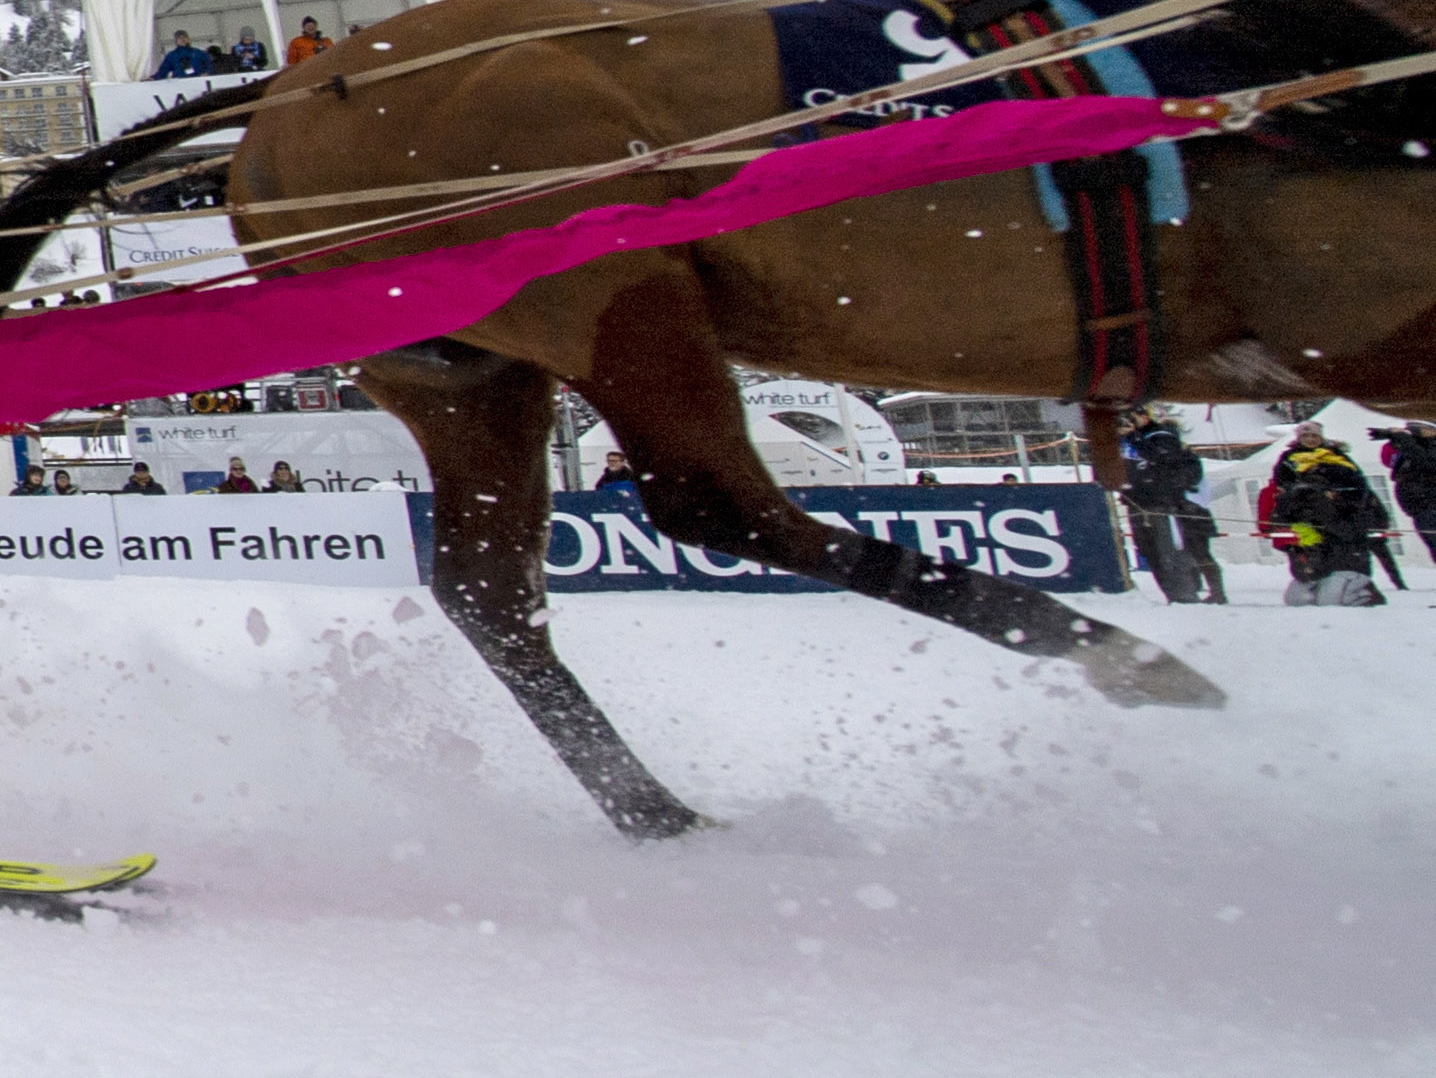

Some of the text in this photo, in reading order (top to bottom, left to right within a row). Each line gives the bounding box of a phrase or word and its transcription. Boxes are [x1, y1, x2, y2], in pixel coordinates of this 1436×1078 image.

[129, 248, 185, 263] CREDIT
[158, 425, 237, 440] white turf
[294, 469, 380, 493] hite
[122, 535, 193, 561] am
[209, 526, 386, 561] Fahren
